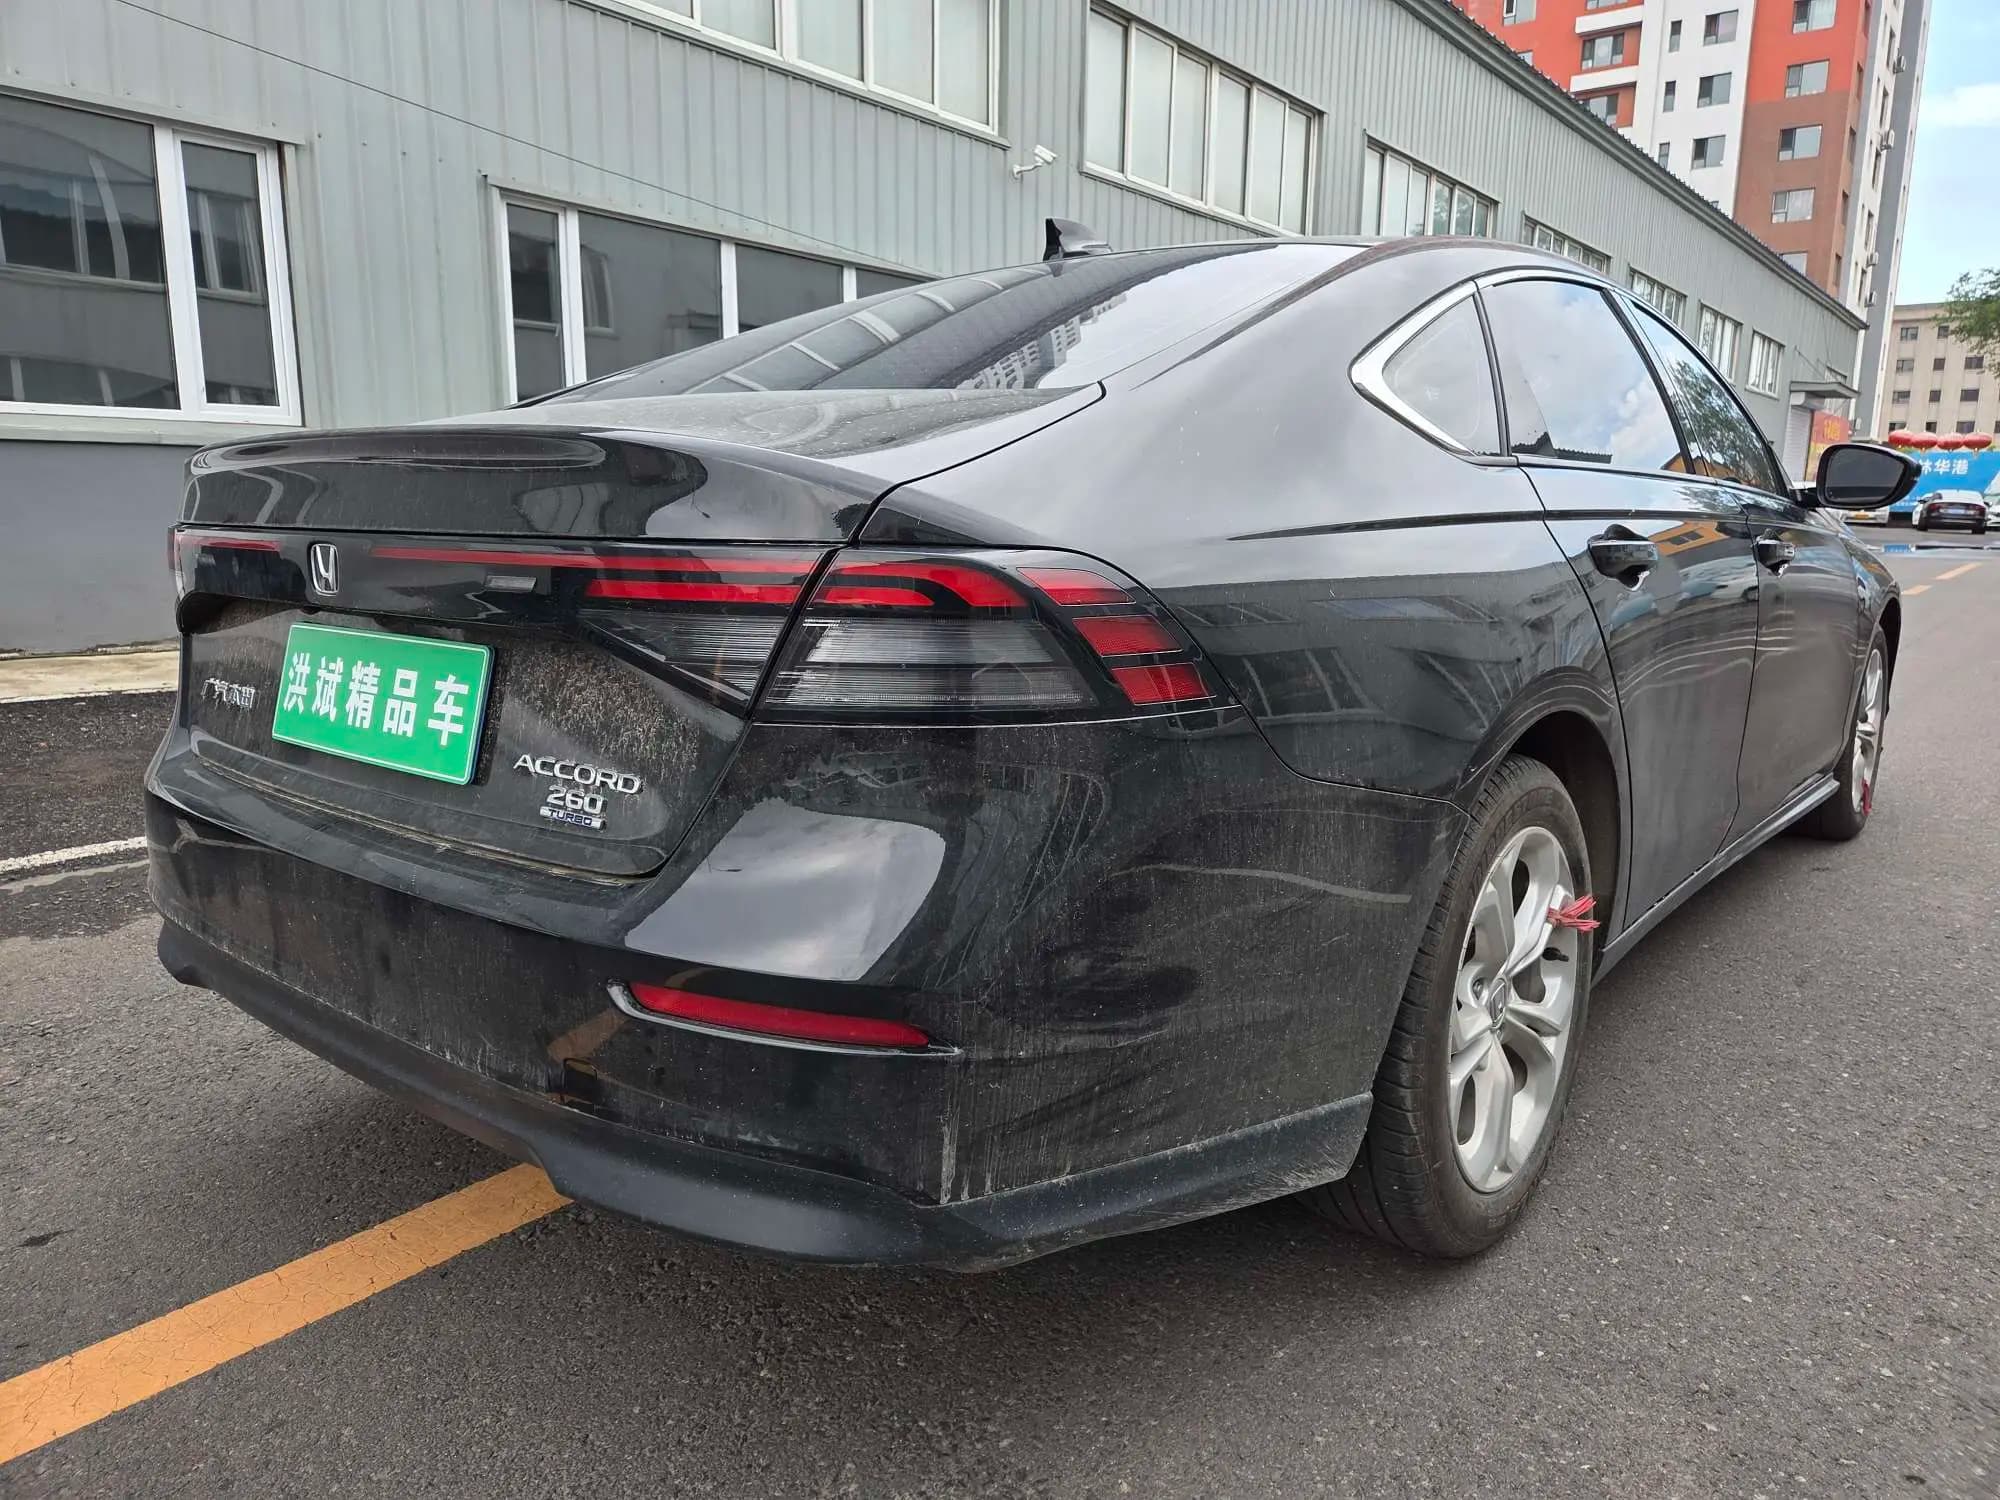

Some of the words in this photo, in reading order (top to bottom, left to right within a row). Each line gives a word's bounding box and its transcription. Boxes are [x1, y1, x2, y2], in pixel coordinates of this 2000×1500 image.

[283, 651, 471, 746] 洪斌精品车
[513, 754, 642, 795] ACCORD
[546, 785, 605, 815] 260
[547, 809, 594, 827] TURBO
